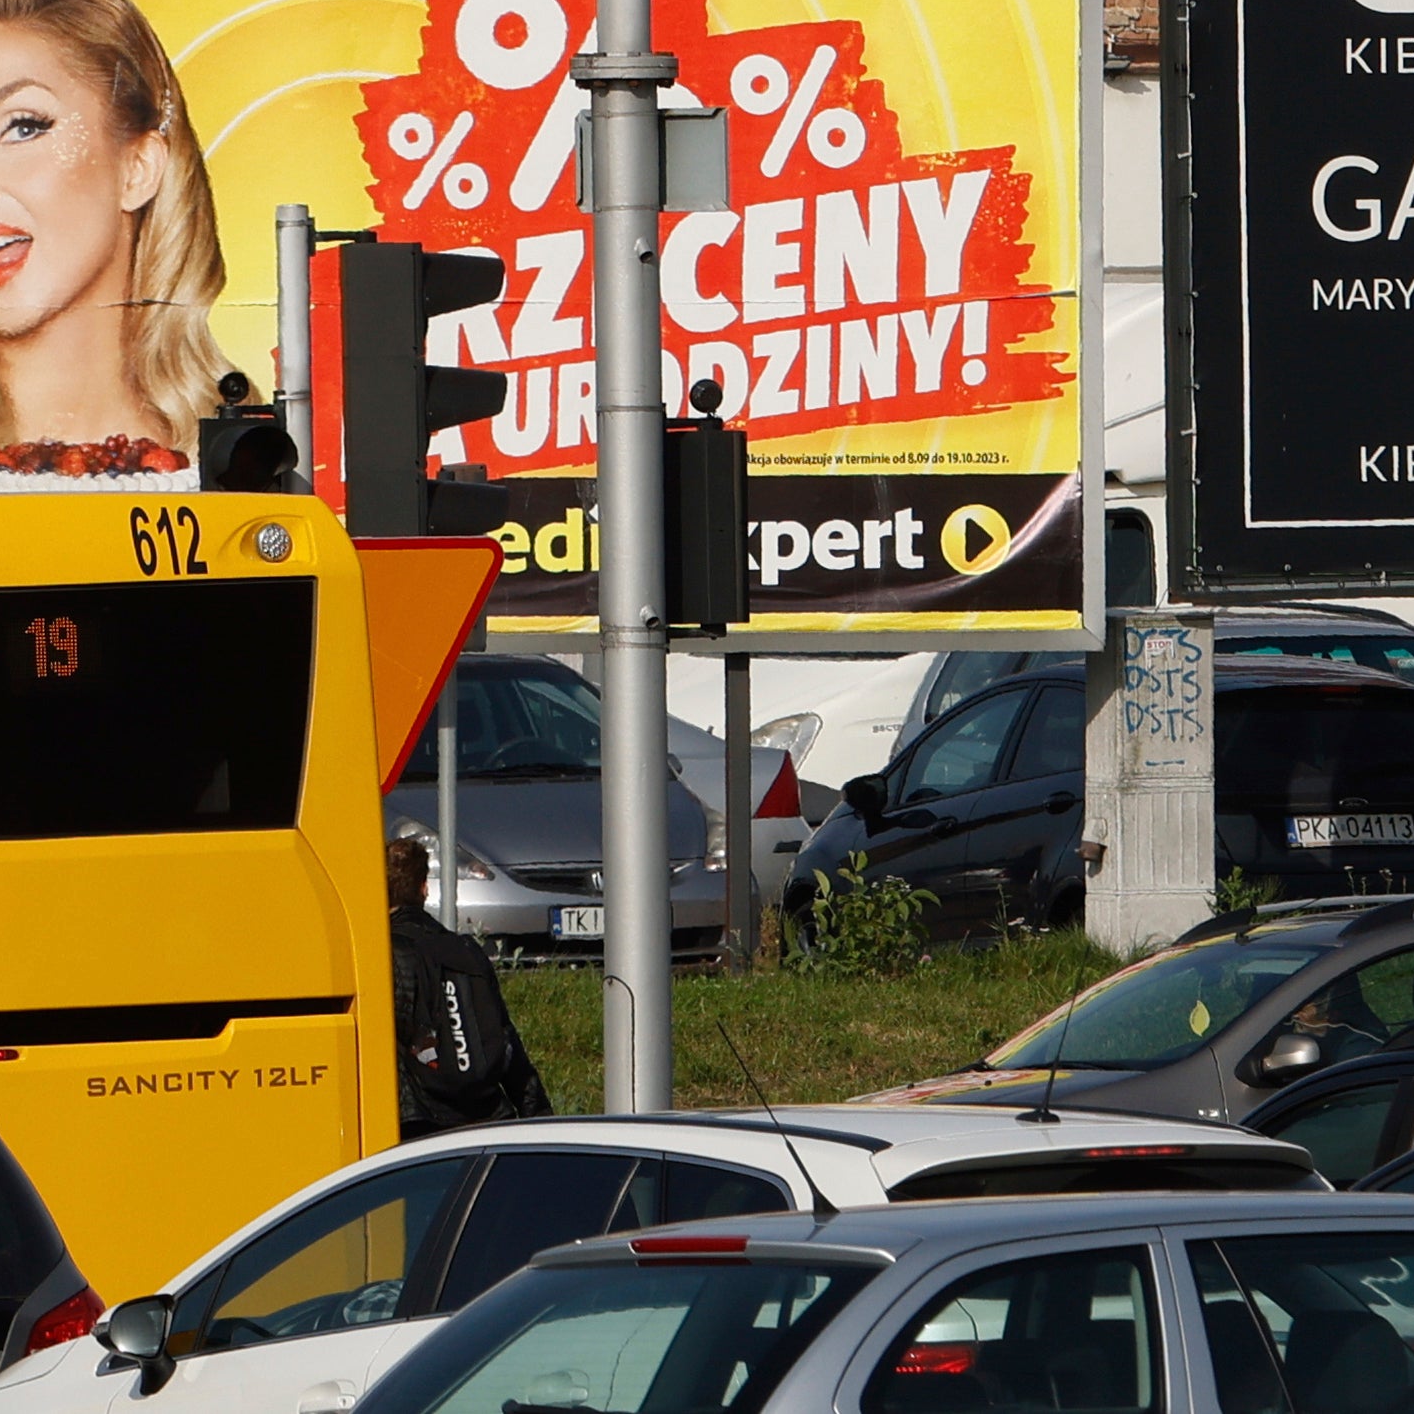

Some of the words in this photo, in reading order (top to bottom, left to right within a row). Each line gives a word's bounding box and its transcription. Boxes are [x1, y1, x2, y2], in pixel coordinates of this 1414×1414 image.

[426, 169, 991, 365] RZCENY
[773, 452, 833, 468] obowiązuje
[834, 455, 844, 465] w
[846, 452, 891, 465] terminie
[892, 451, 906, 465] od
[907, 452, 930, 465] 8.09
[931, 452, 945, 465] do
[946, 452, 1000, 465] 19.10.2023
[1001, 455, 1010, 464] r.
[130, 506, 209, 577] 612
[488, 507, 598, 574] edi
[748, 507, 924, 586] pert
[25, 616, 78, 677] 19
[1297, 818, 1341, 841] PKA
[1346, 816, 1413, 839] 04113
[86, 1068, 241, 1098] SANCITY
[252, 1064, 330, 1089] 12LF
